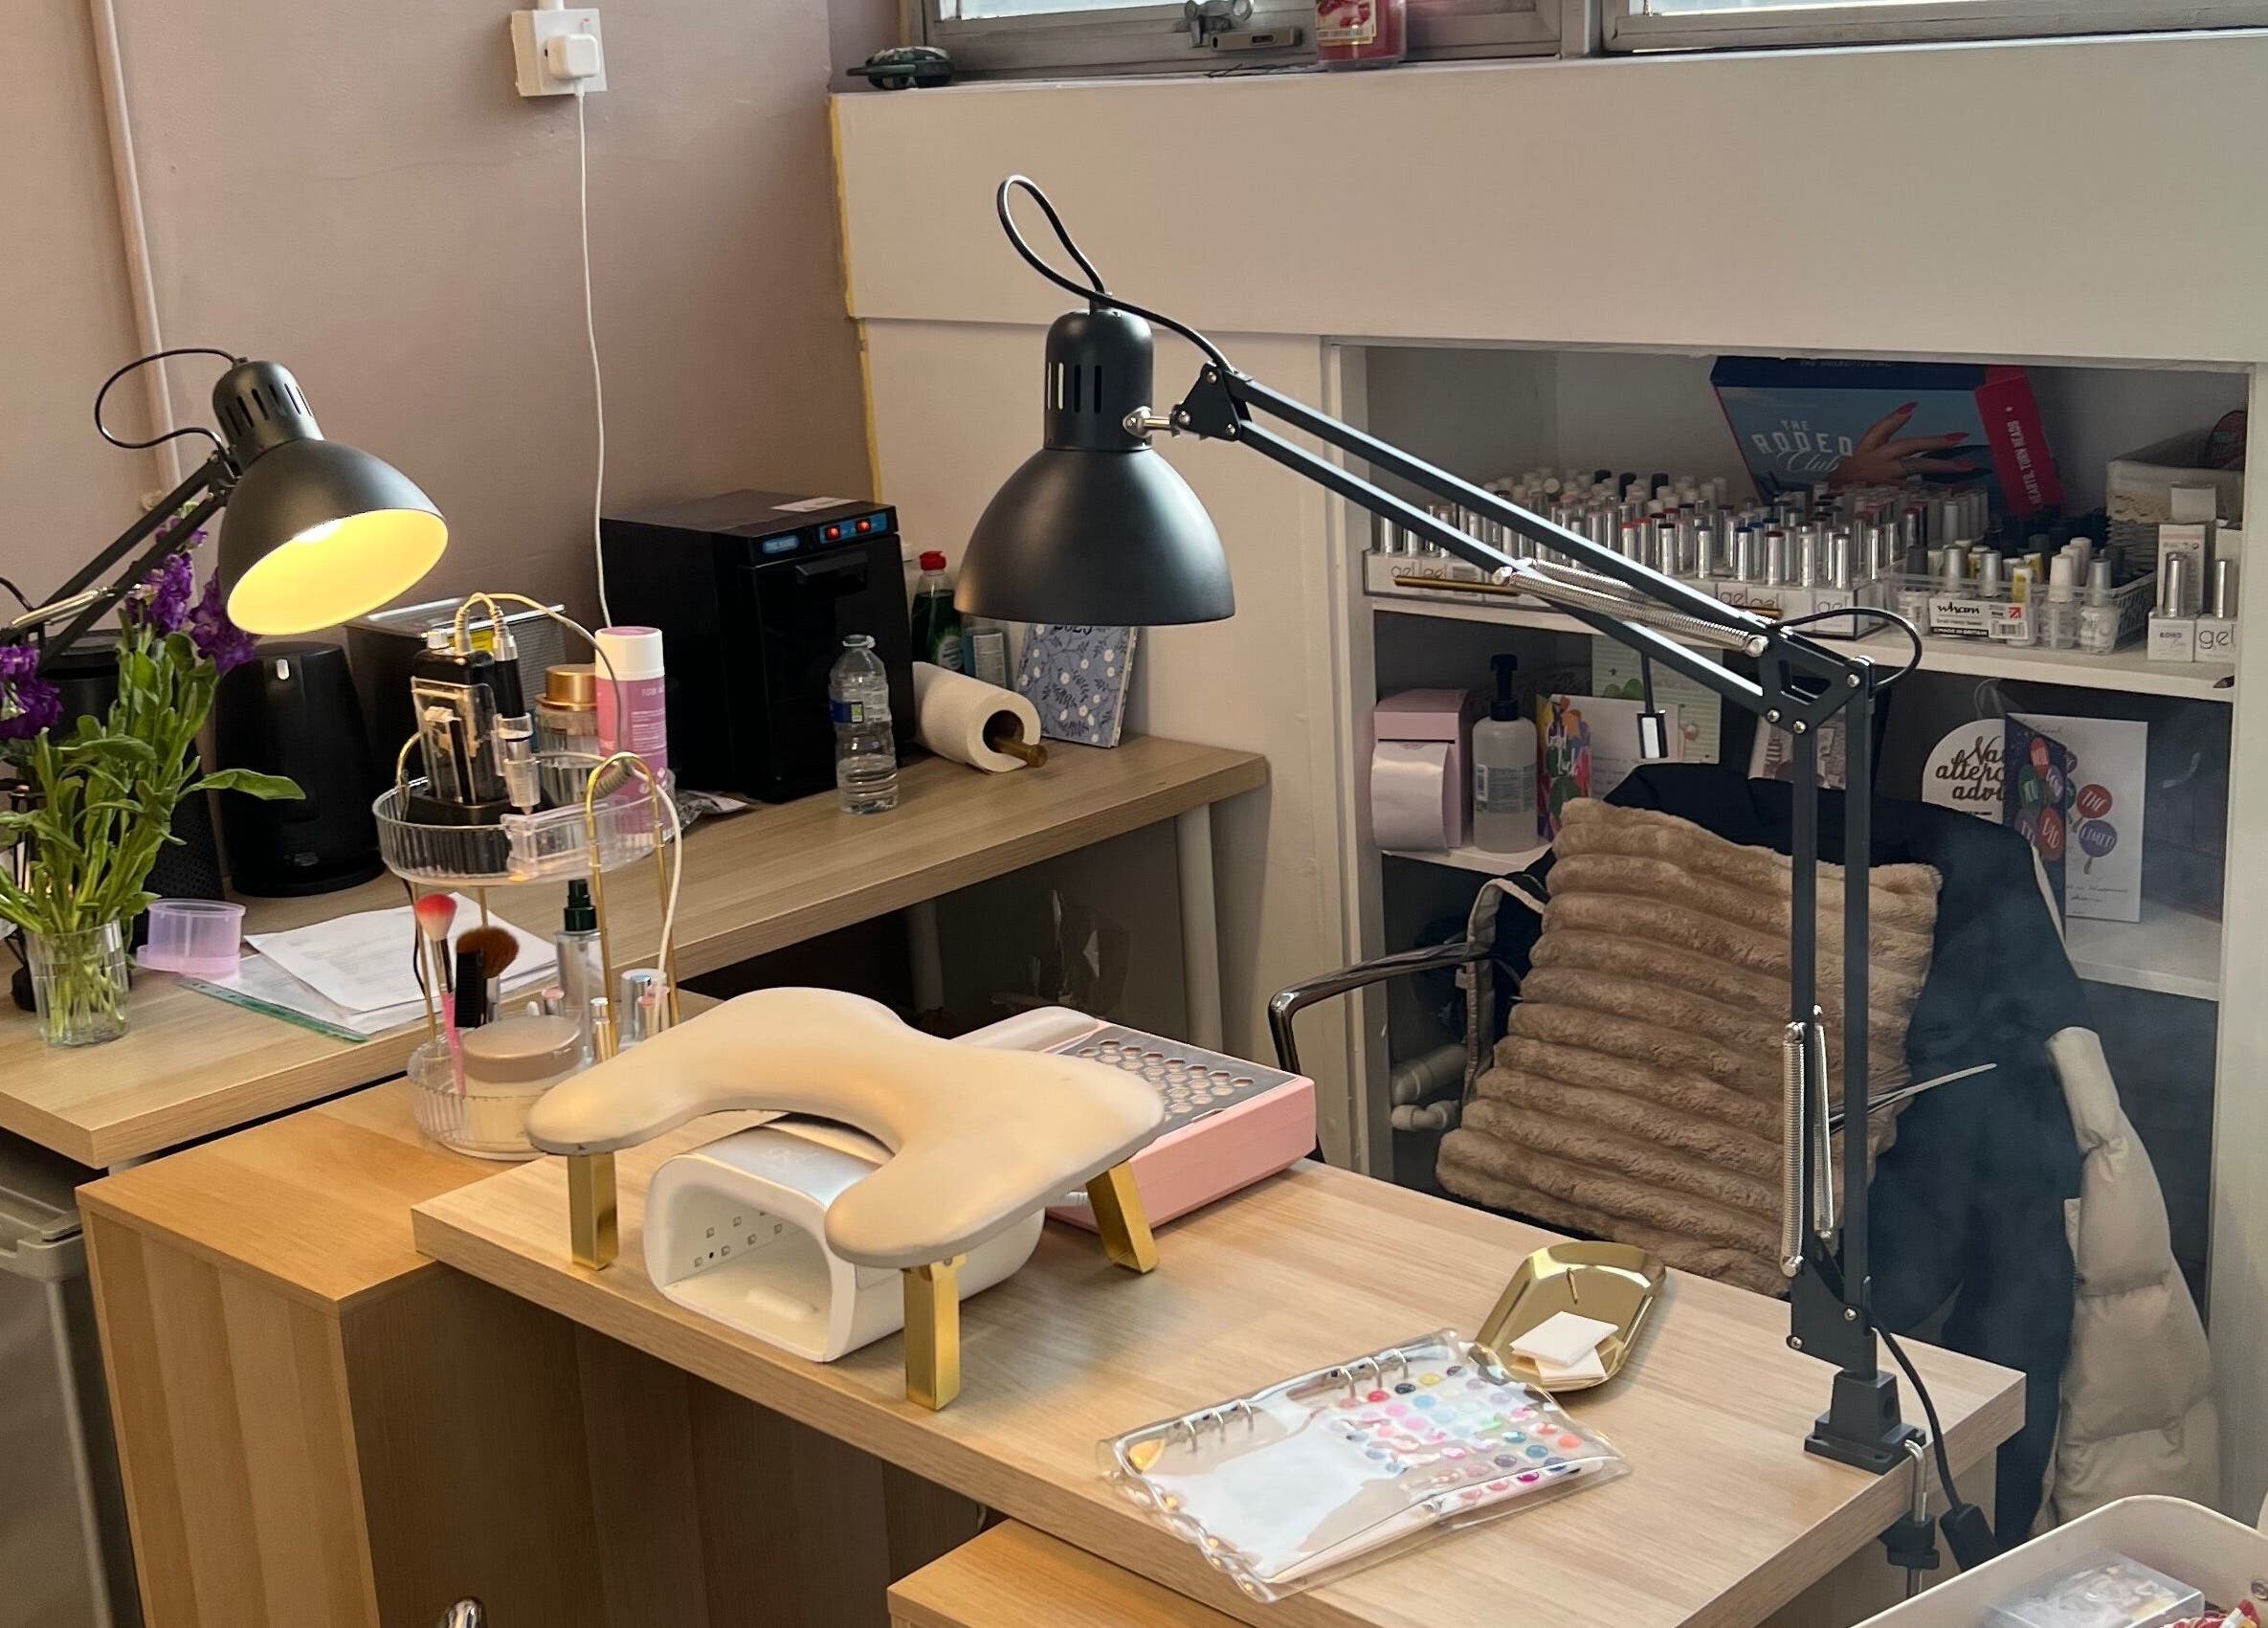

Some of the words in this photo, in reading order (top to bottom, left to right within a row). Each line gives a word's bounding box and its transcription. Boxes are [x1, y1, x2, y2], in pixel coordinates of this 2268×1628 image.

[1780, 419, 1812, 432] THE
[1750, 432, 1854, 457] RODEO
[1776, 449, 1843, 474] Club
[2198, 624, 2235, 649] gel
